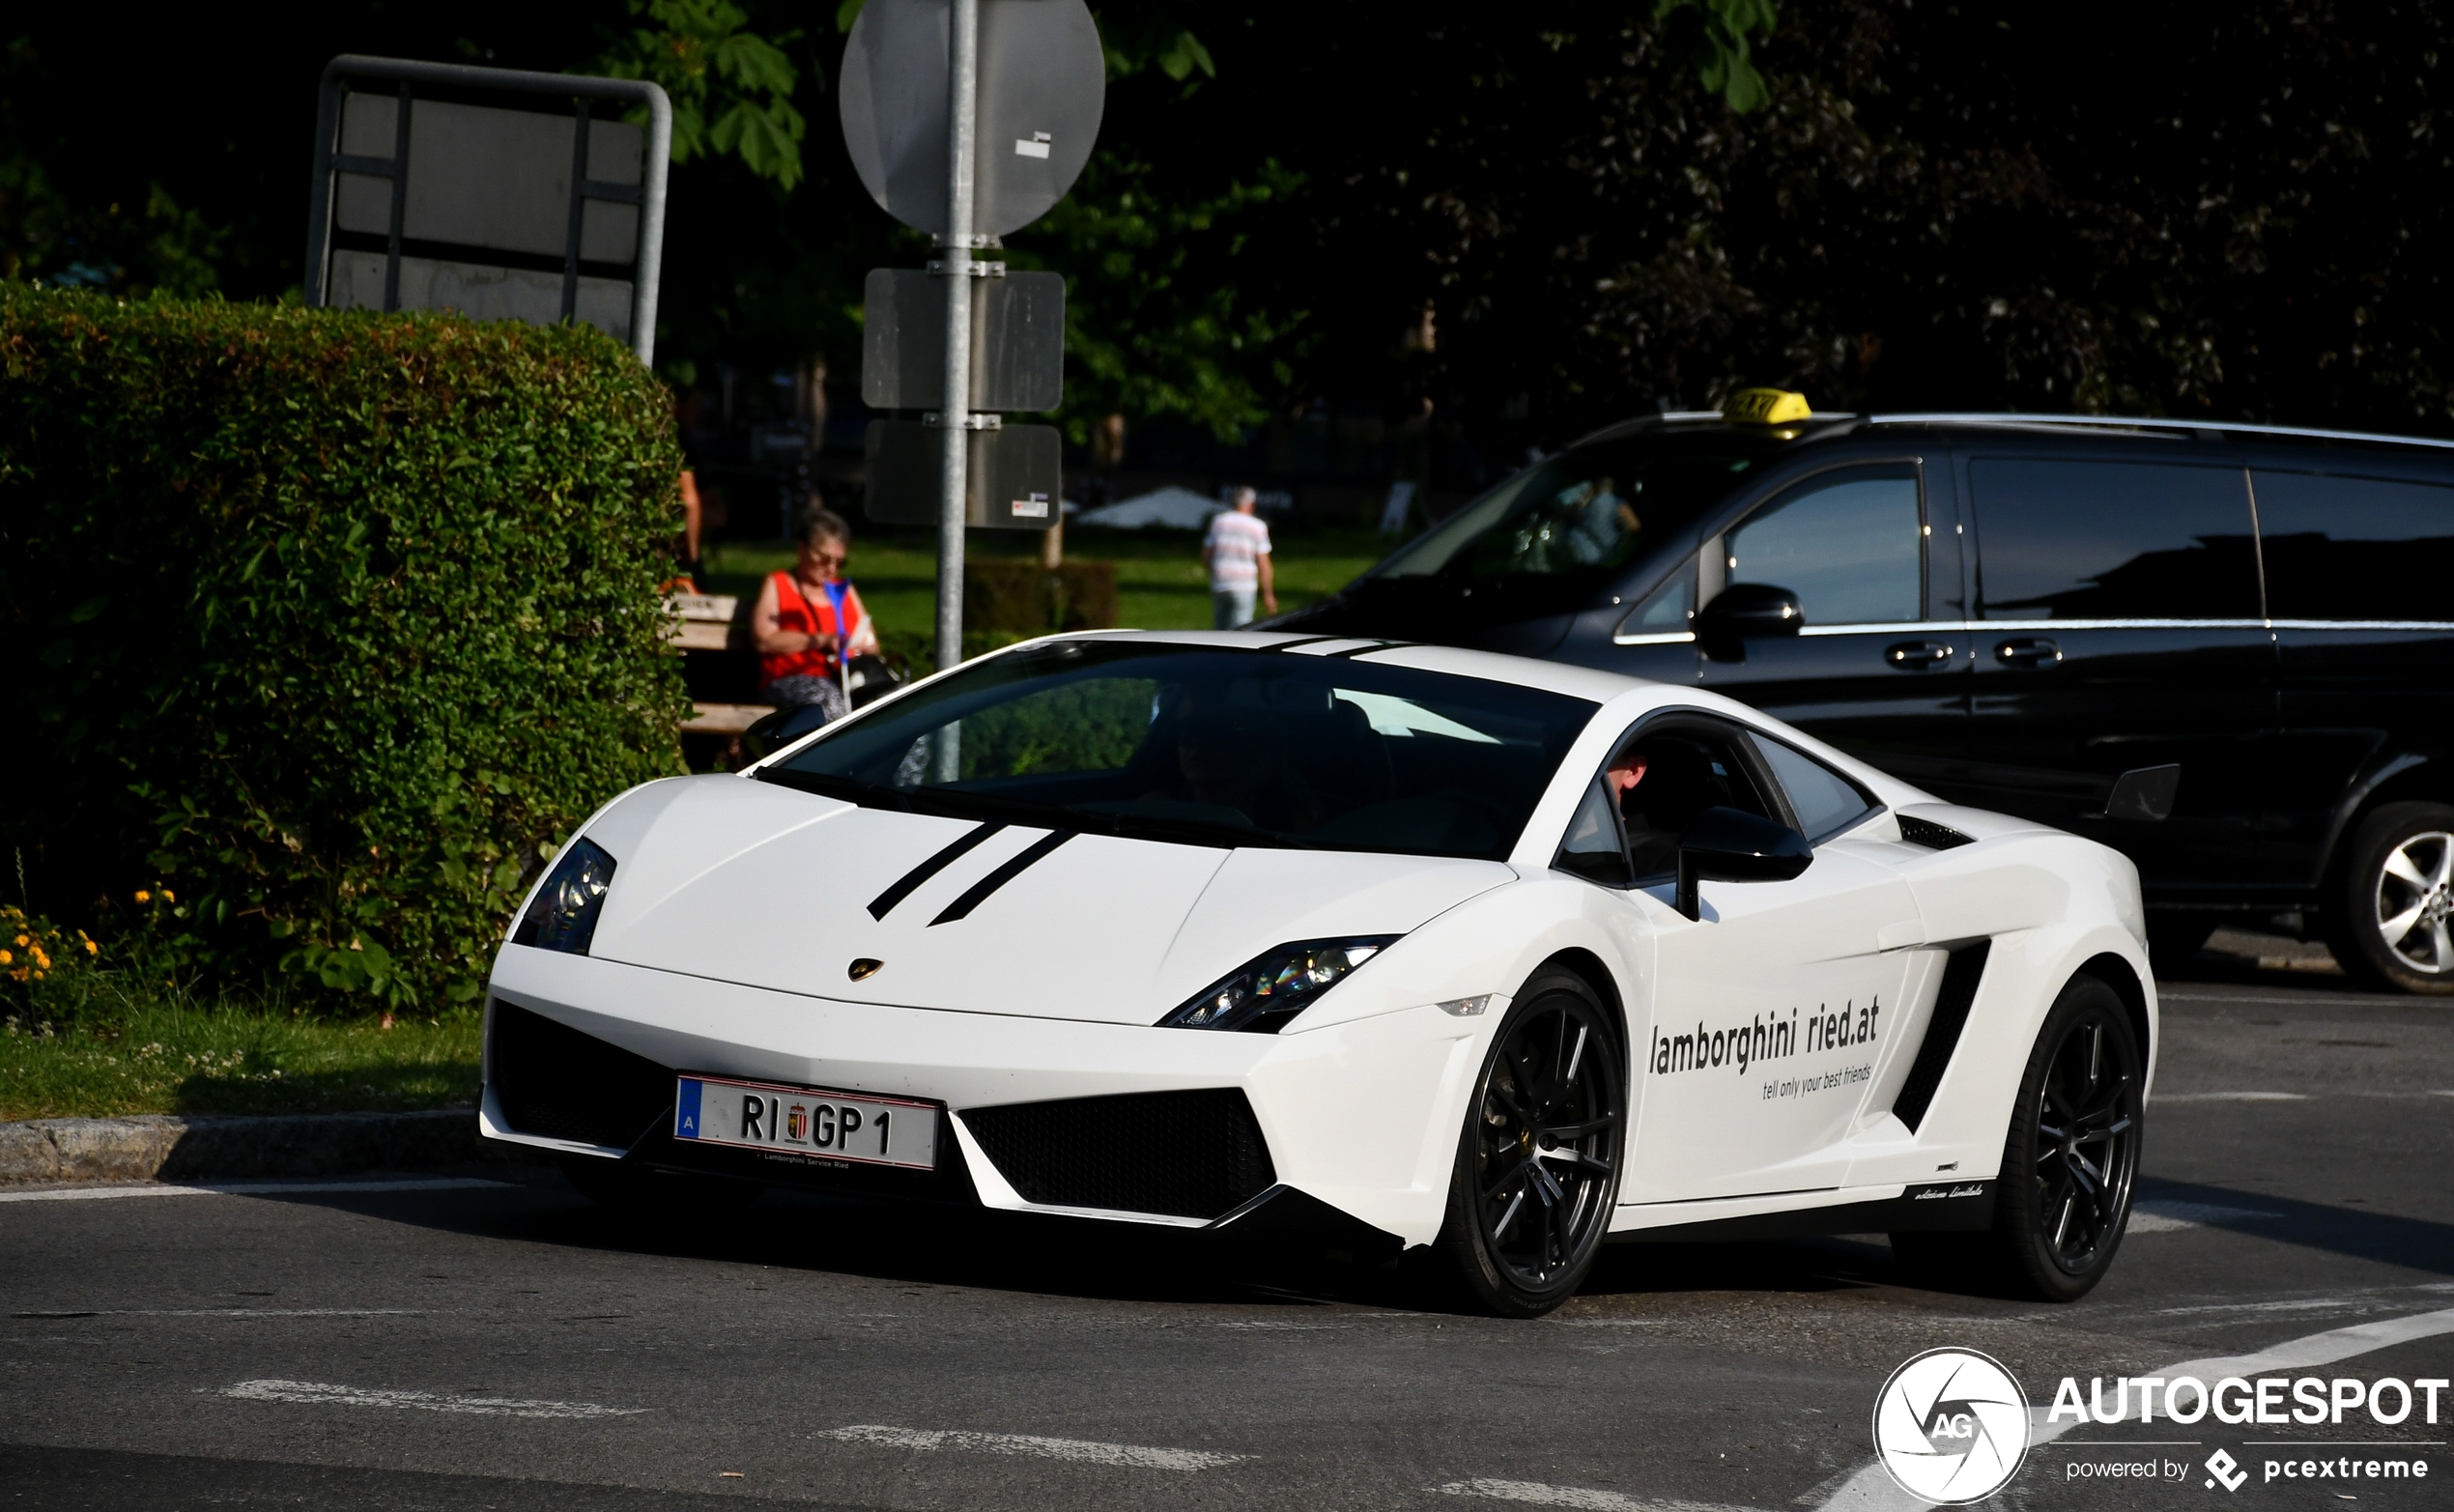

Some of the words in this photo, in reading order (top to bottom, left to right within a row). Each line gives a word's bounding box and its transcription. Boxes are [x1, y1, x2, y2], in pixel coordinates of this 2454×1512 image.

[1649, 1008, 1797, 1075] lamborghini
[1808, 994, 1879, 1053] ried.at
[1763, 1080, 1779, 1099] tell
[1781, 1075, 1800, 1098] only
[1801, 1071, 1822, 1098] your
[1823, 1069, 1843, 1091] best
[1844, 1063, 1870, 1086] friends
[684, 1116, 694, 1129] A
[741, 1095, 779, 1140] RI
[813, 1104, 863, 1150] GP
[873, 1110, 892, 1155] 1
[764, 1153, 805, 1163] Lamborghini
[807, 1158, 832, 1167] Service
